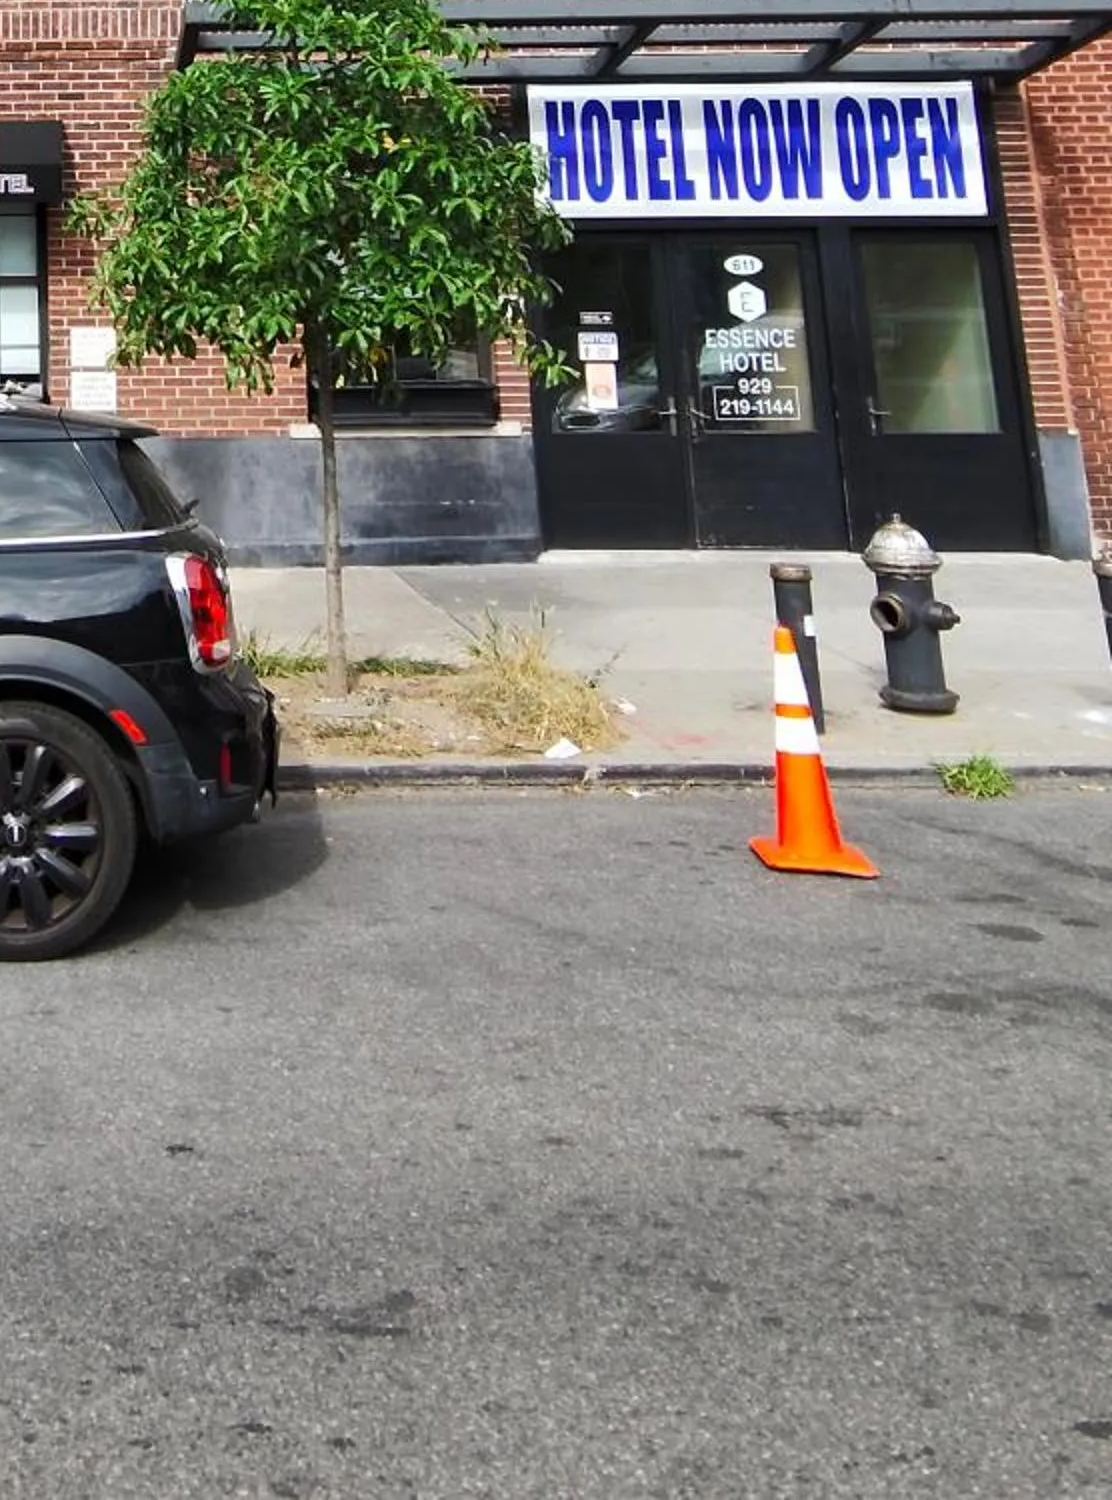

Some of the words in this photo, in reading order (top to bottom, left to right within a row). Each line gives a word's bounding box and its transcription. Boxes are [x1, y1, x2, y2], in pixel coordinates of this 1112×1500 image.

[545, 99, 696, 202] HOTEL
[703, 97, 823, 202] NOW
[835, 96, 968, 202] OPEN
[705, 329, 796, 348] ESSENCE
[720, 353, 787, 372] HOTEL
[738, 378, 772, 394] 929
[720, 400, 794, 415] 219-1144
